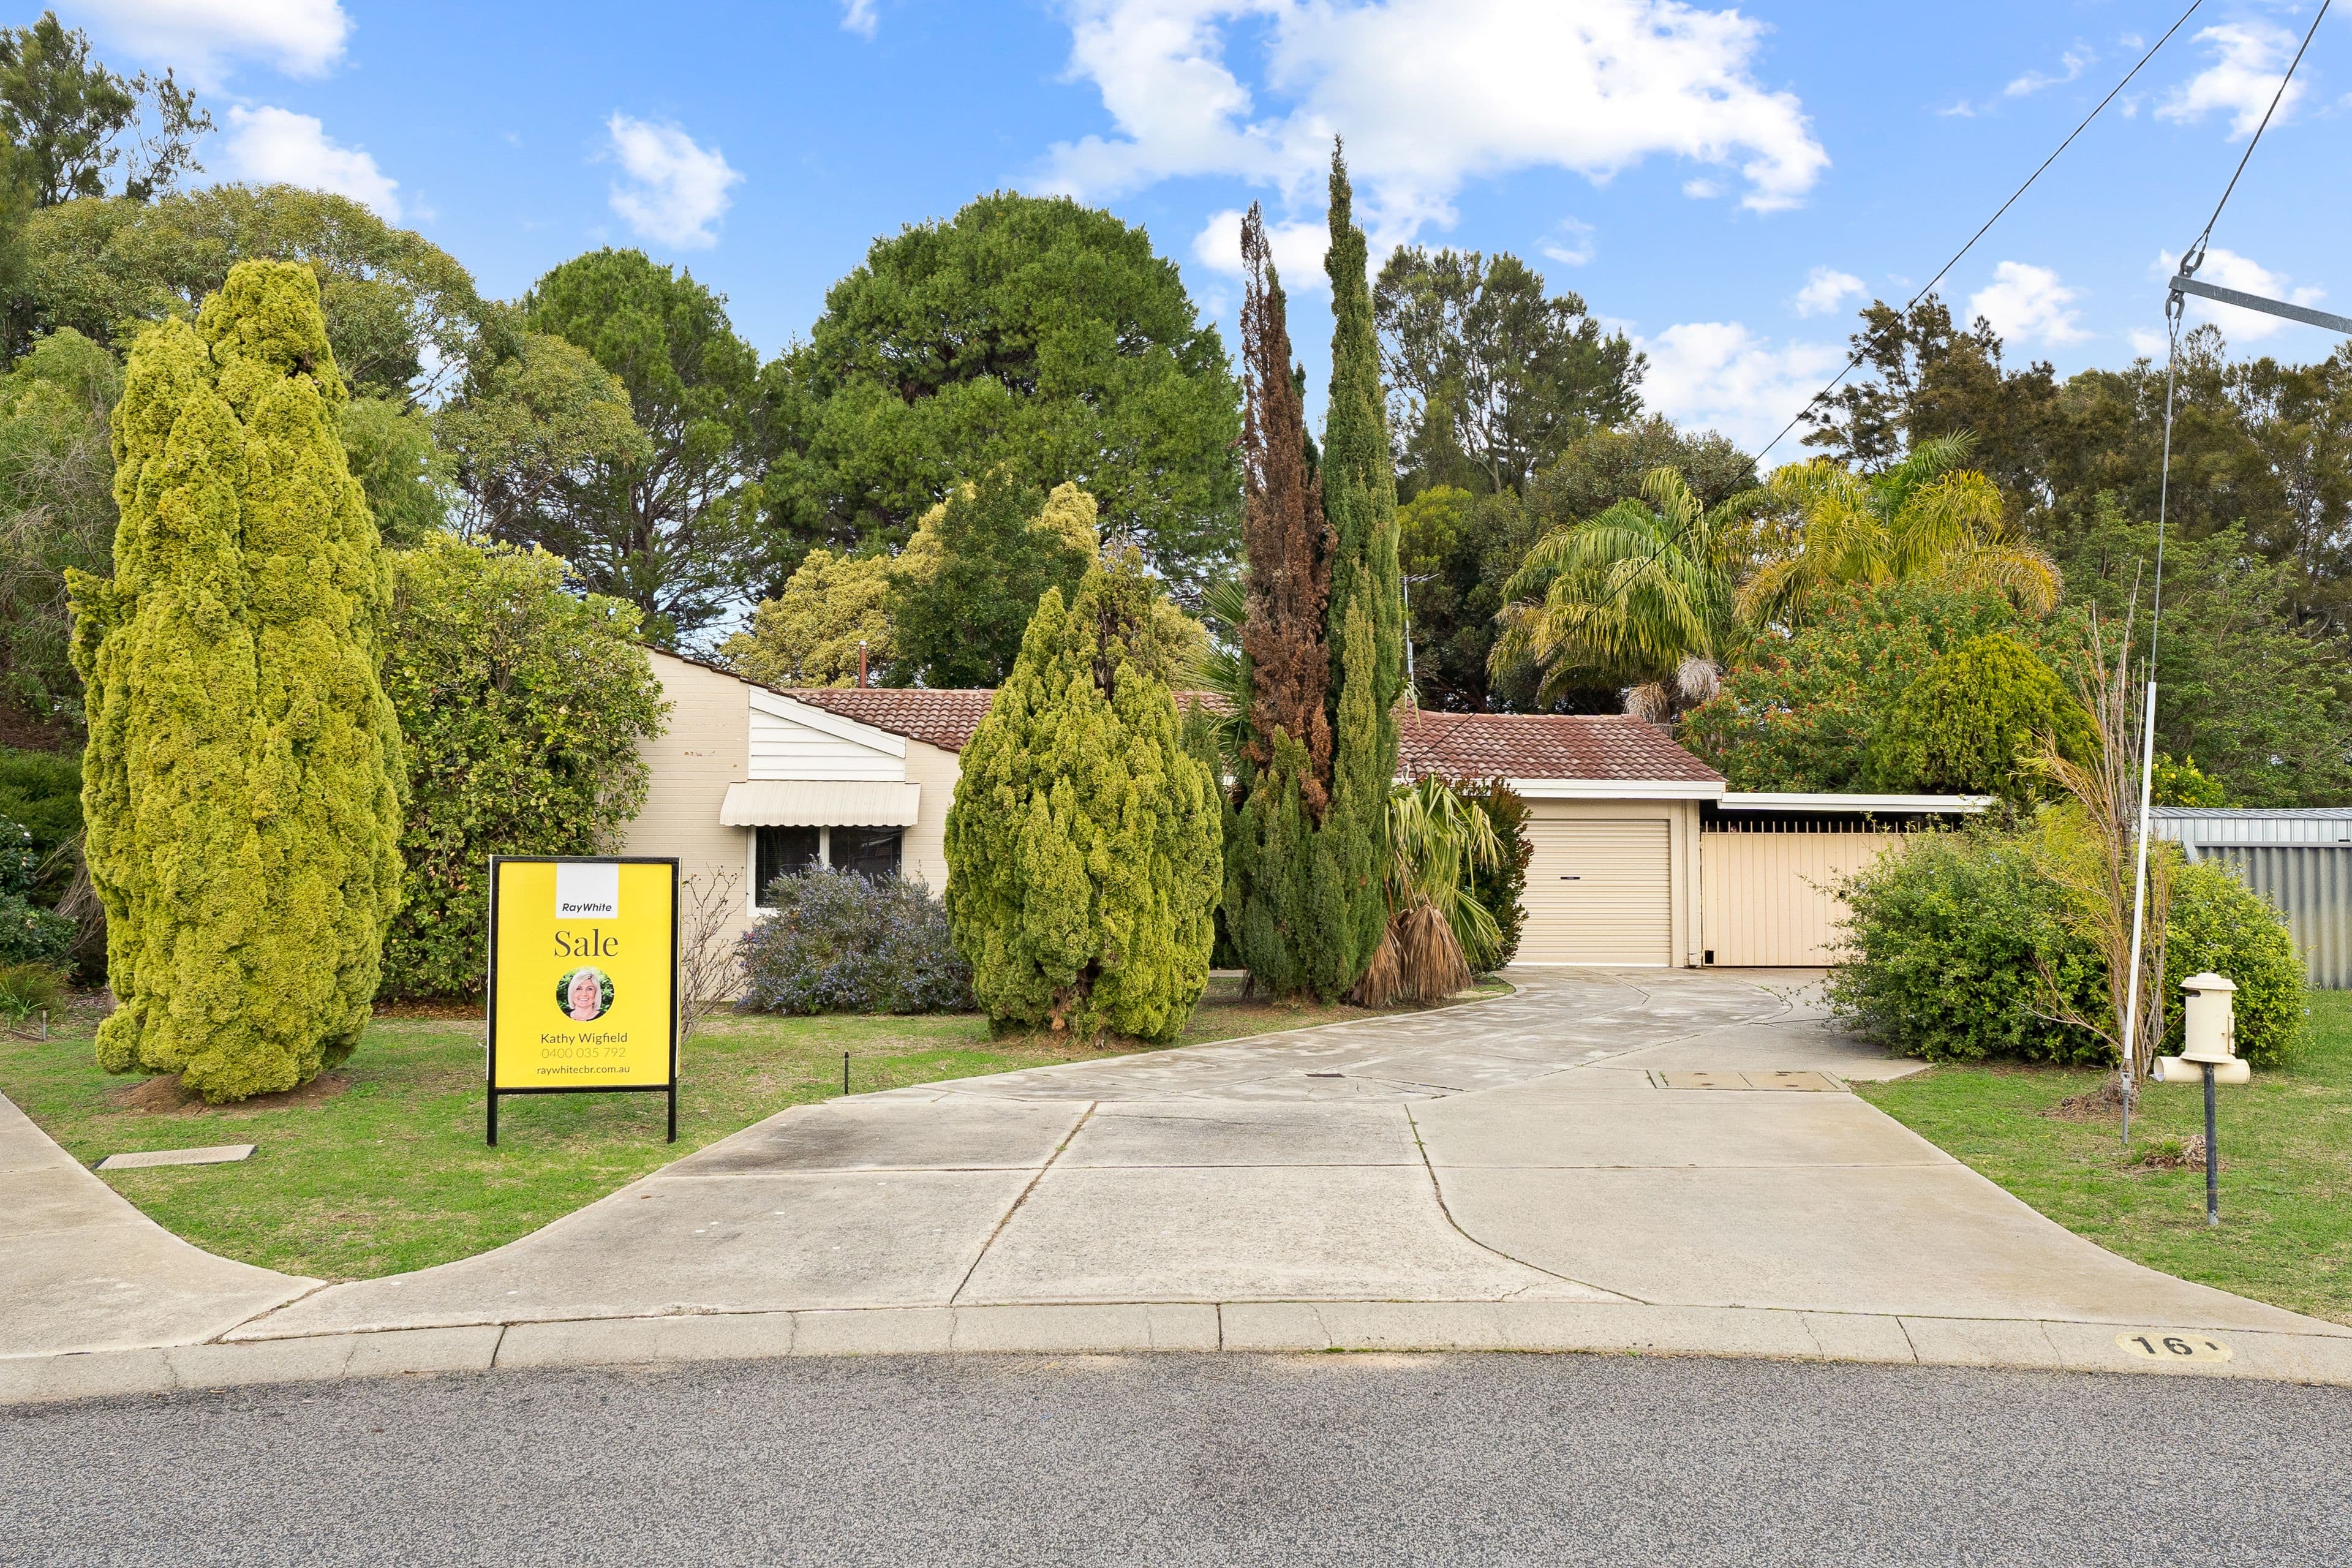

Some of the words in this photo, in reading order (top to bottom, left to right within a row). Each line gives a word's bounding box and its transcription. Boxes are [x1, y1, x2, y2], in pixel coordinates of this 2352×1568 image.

[554, 929, 619, 957] Sale
[541, 1033, 575, 1045] Kathy
[578, 1032, 627, 1044] Wigfield
[541, 1048, 573, 1058] 0400
[576, 1047, 598, 1058] 035
[604, 1047, 626, 1058] 792
[537, 1065, 630, 1076] raywhitecbr.com.au
[2132, 1336, 2193, 1355] 16
